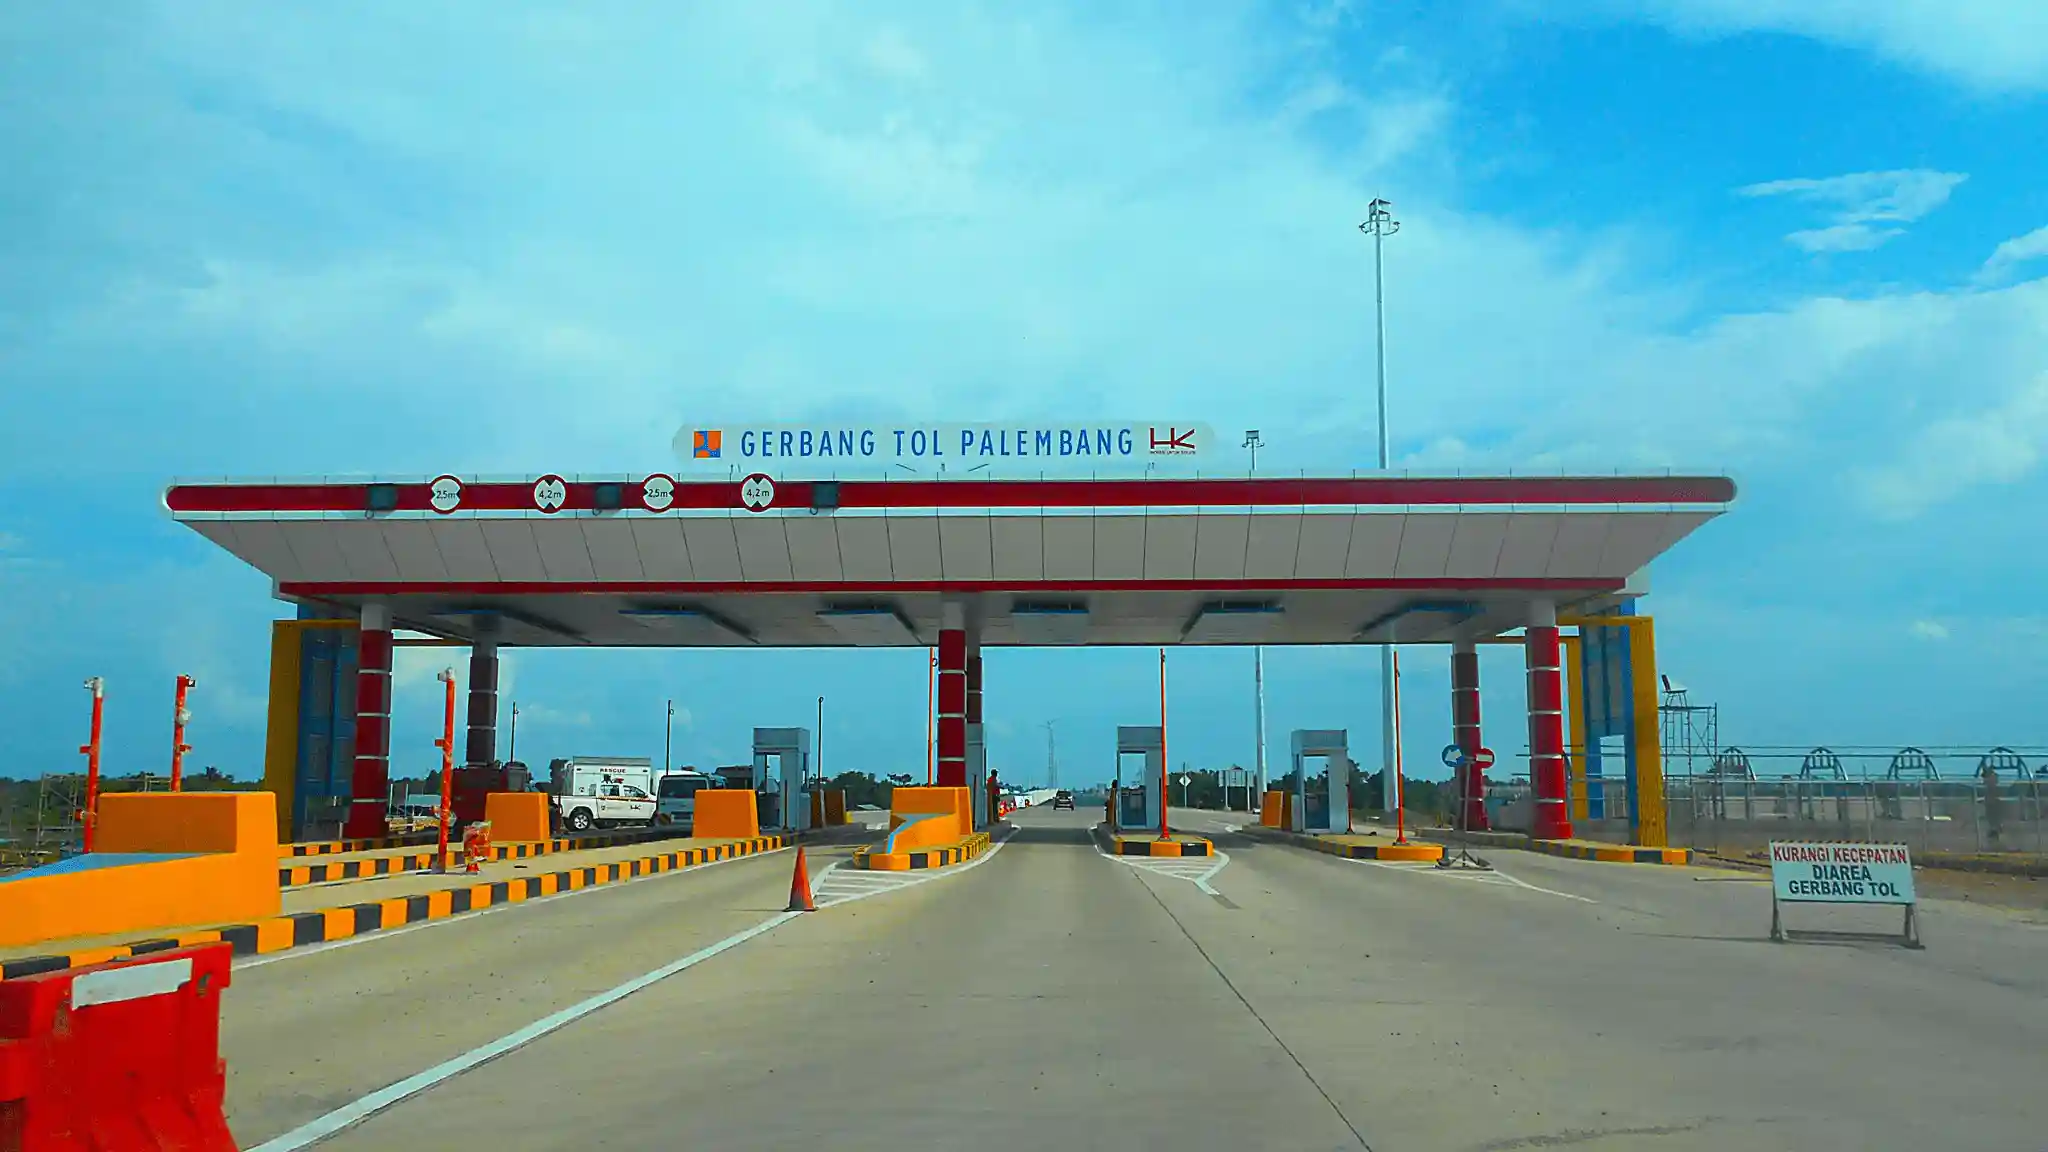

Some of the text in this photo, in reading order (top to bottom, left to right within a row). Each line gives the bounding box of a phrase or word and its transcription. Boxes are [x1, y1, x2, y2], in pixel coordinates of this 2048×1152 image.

[741, 429, 1133, 457] GERBANG TOL PALEMBANG
[1773, 846, 1907, 864] KURANGI KECEPATAN
[1812, 865, 1872, 881] DIAREA
[1788, 880, 1901, 897] GERBANG TOL
